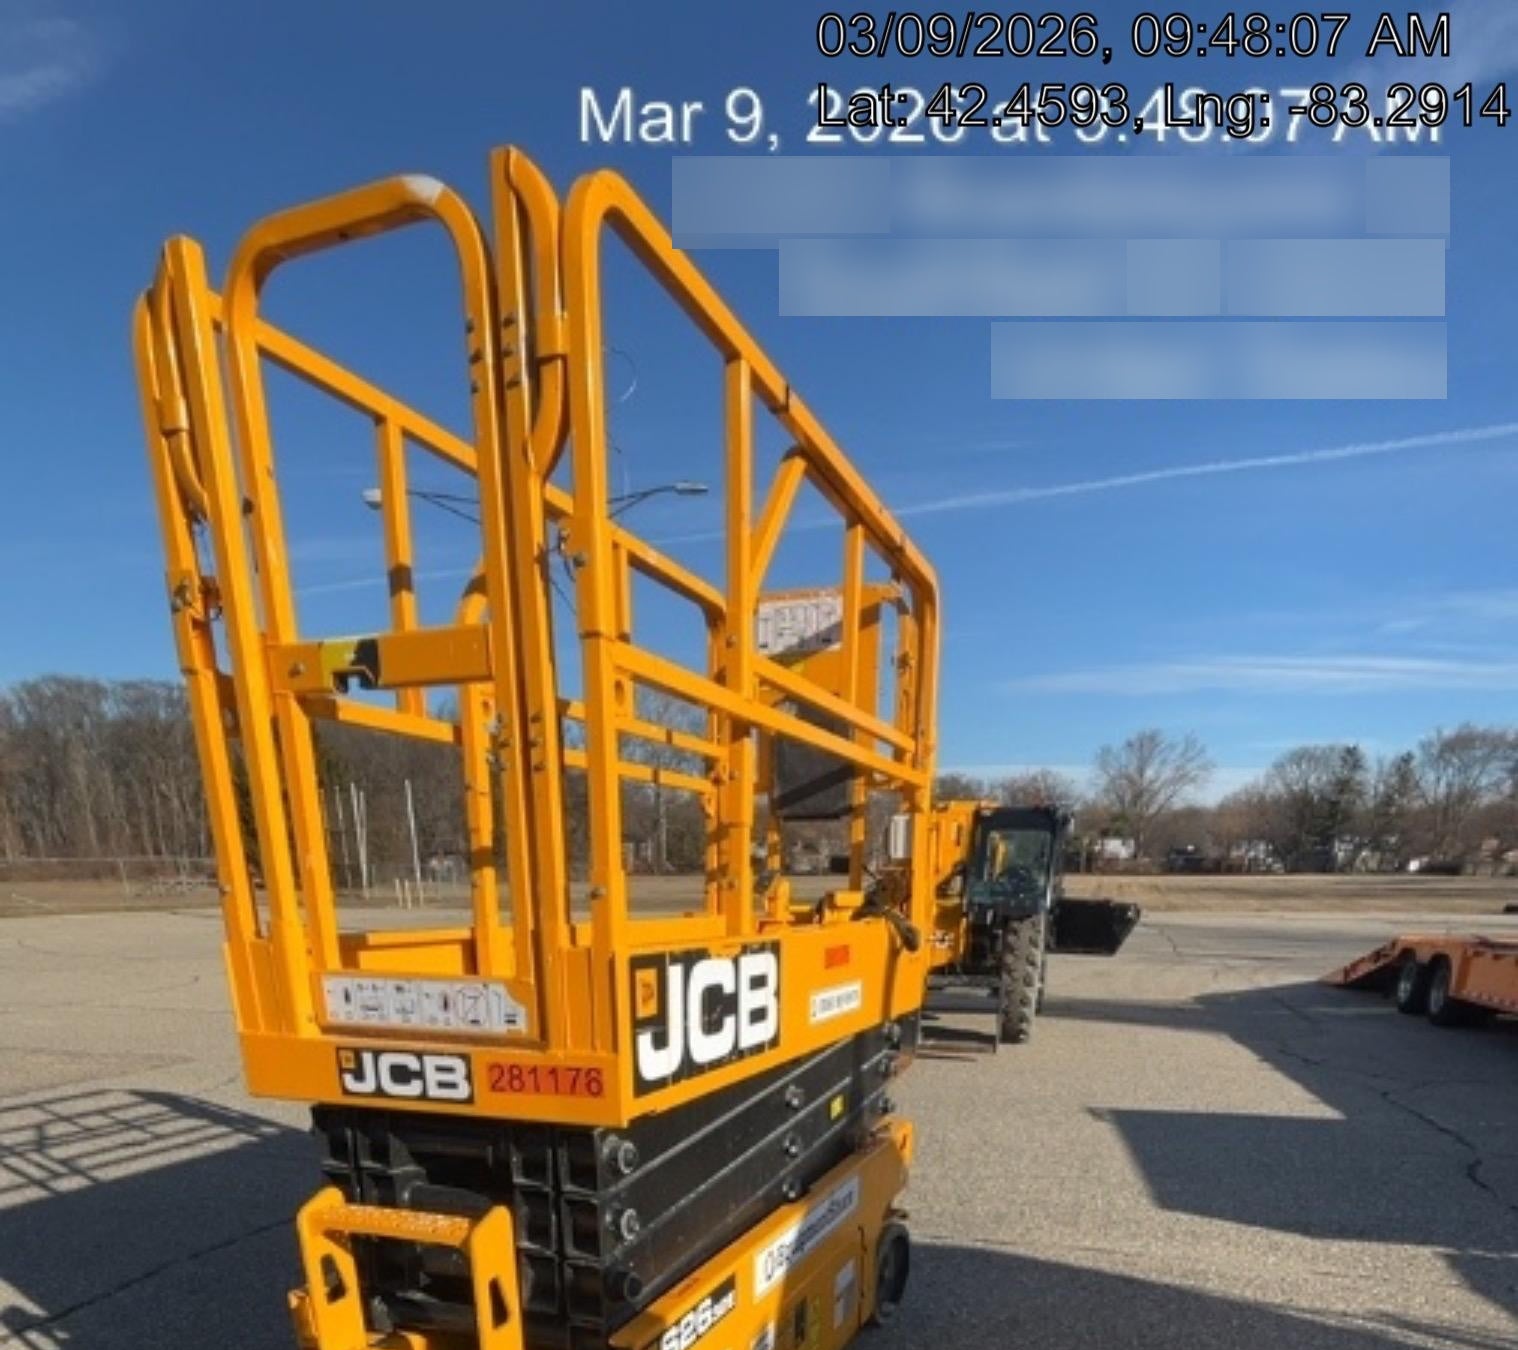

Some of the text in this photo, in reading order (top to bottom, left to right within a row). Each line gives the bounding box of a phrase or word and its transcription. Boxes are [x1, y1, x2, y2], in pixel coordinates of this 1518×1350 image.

[636, 951, 779, 1081] JCB
[342, 1052, 604, 1100] JCB 281176
